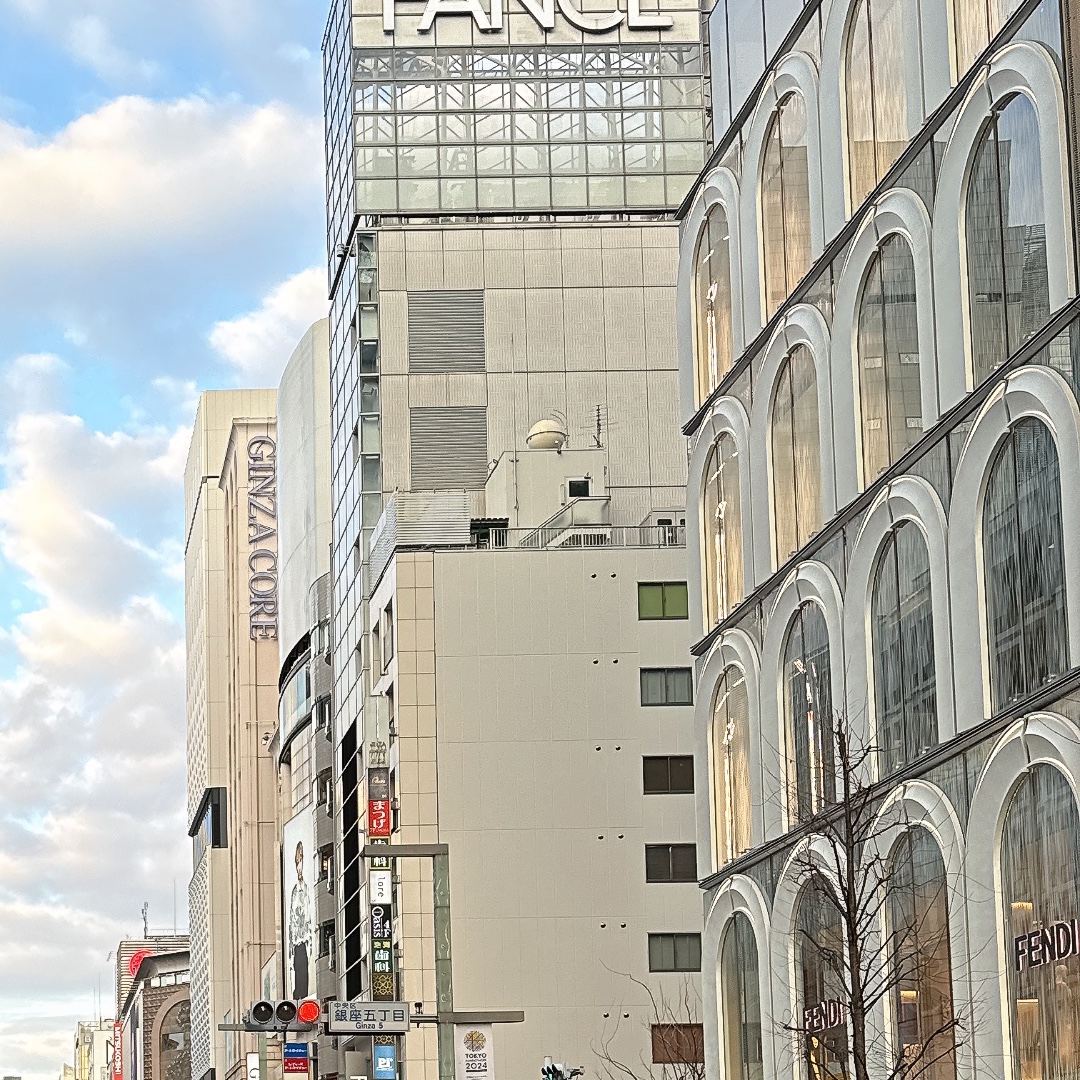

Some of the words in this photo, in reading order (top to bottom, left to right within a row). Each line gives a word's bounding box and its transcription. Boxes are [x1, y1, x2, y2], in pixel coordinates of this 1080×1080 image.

[247, 436, 276, 545] GINZA
[248, 548, 278, 641] CORE
[372, 800, 386, 829] まつげ
[371, 905, 384, 938] Oasis
[1014, 918, 1080, 972] FENDI
[334, 1009, 405, 1022] 銀座五丁目
[355, 1021, 376, 1030] Ginza
[803, 997, 844, 1032] FENDI
[114, 1026, 122, 1075] MITSUKOSHI
[465, 1062, 488, 1070] 2024
